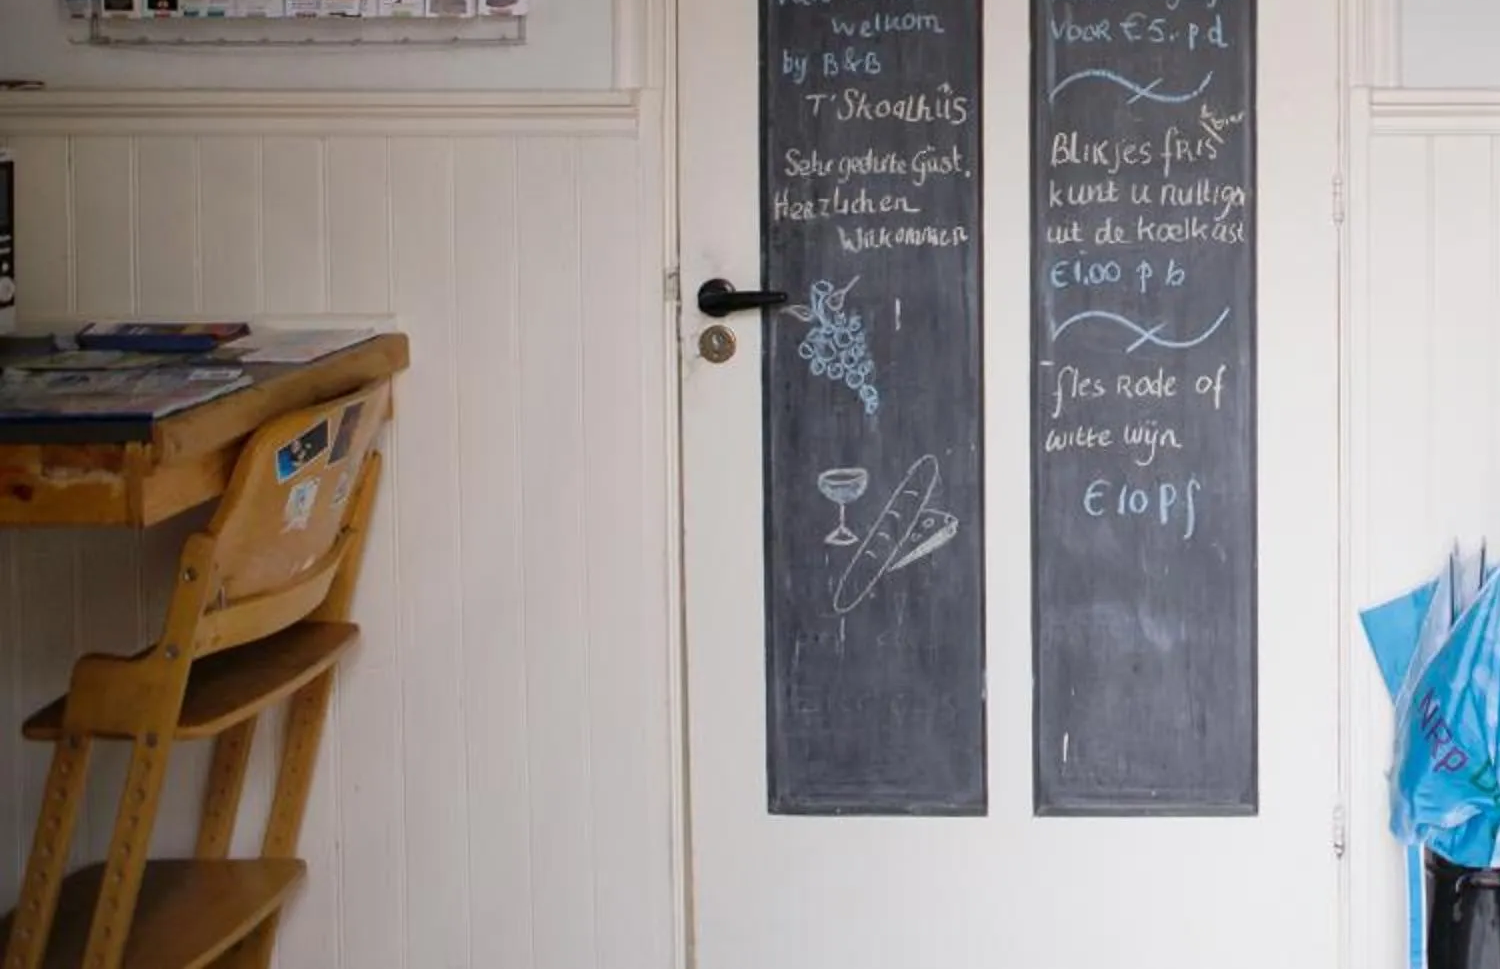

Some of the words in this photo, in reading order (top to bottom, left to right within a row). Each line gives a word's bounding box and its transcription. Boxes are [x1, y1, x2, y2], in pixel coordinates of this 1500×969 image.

[831, 12, 945, 38] welkom
[784, 147, 834, 178] Sehr
[1051, 131, 1152, 174] Blikjes
[1049, 180, 1119, 208] kunt
[1131, 183, 1151, 205] u
[1094, 217, 1133, 245] de
[1195, 364, 1227, 410] of
